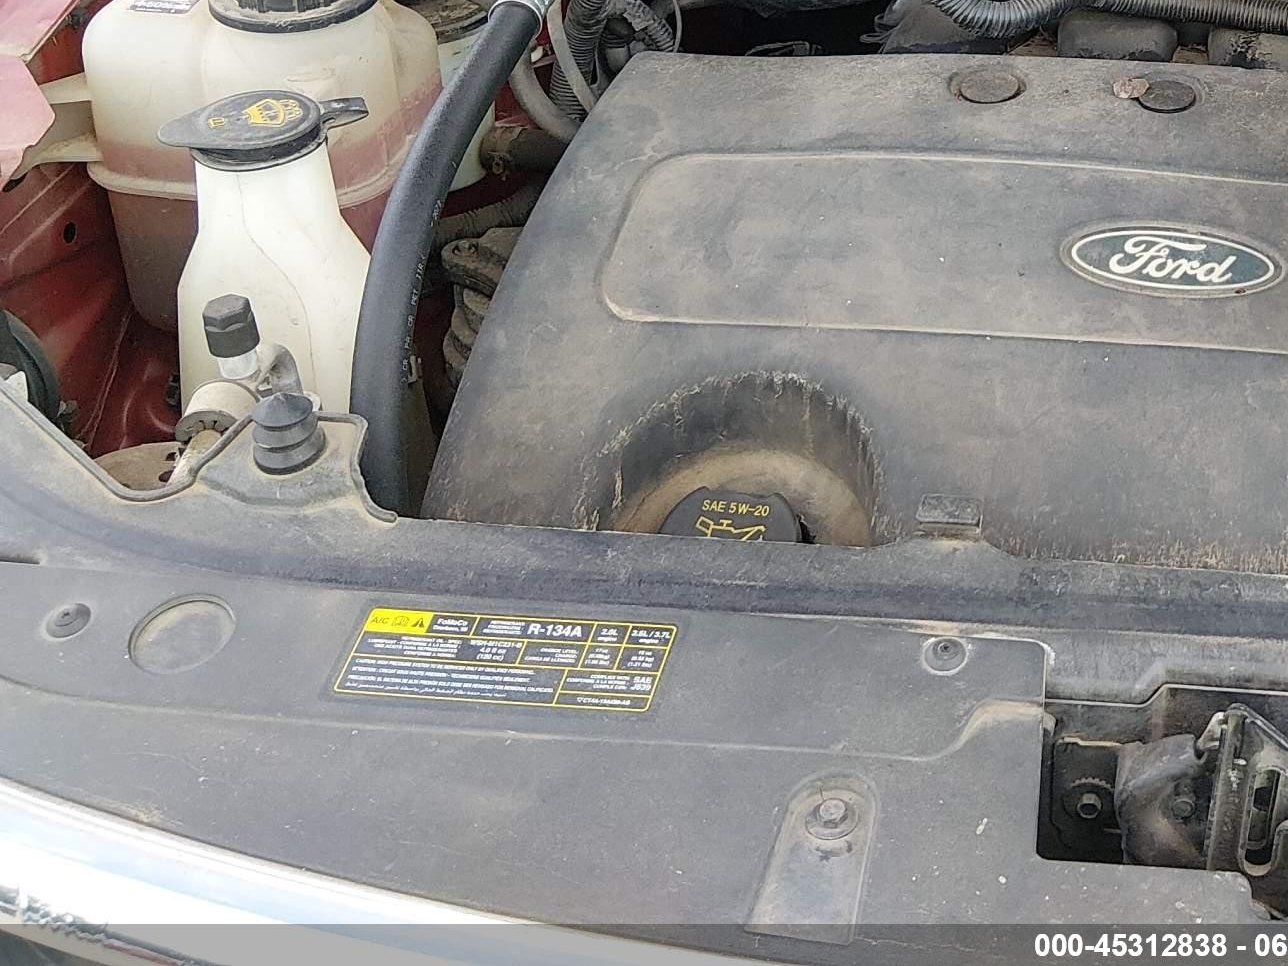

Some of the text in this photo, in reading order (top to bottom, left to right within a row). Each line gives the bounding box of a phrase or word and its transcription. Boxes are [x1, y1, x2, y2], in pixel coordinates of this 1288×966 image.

[1108, 236, 1237, 283] Ford
[702, 499, 770, 517] SAE 5W-20
[371, 616, 390, 624] A/C
[527, 623, 583, 638] R-134A
